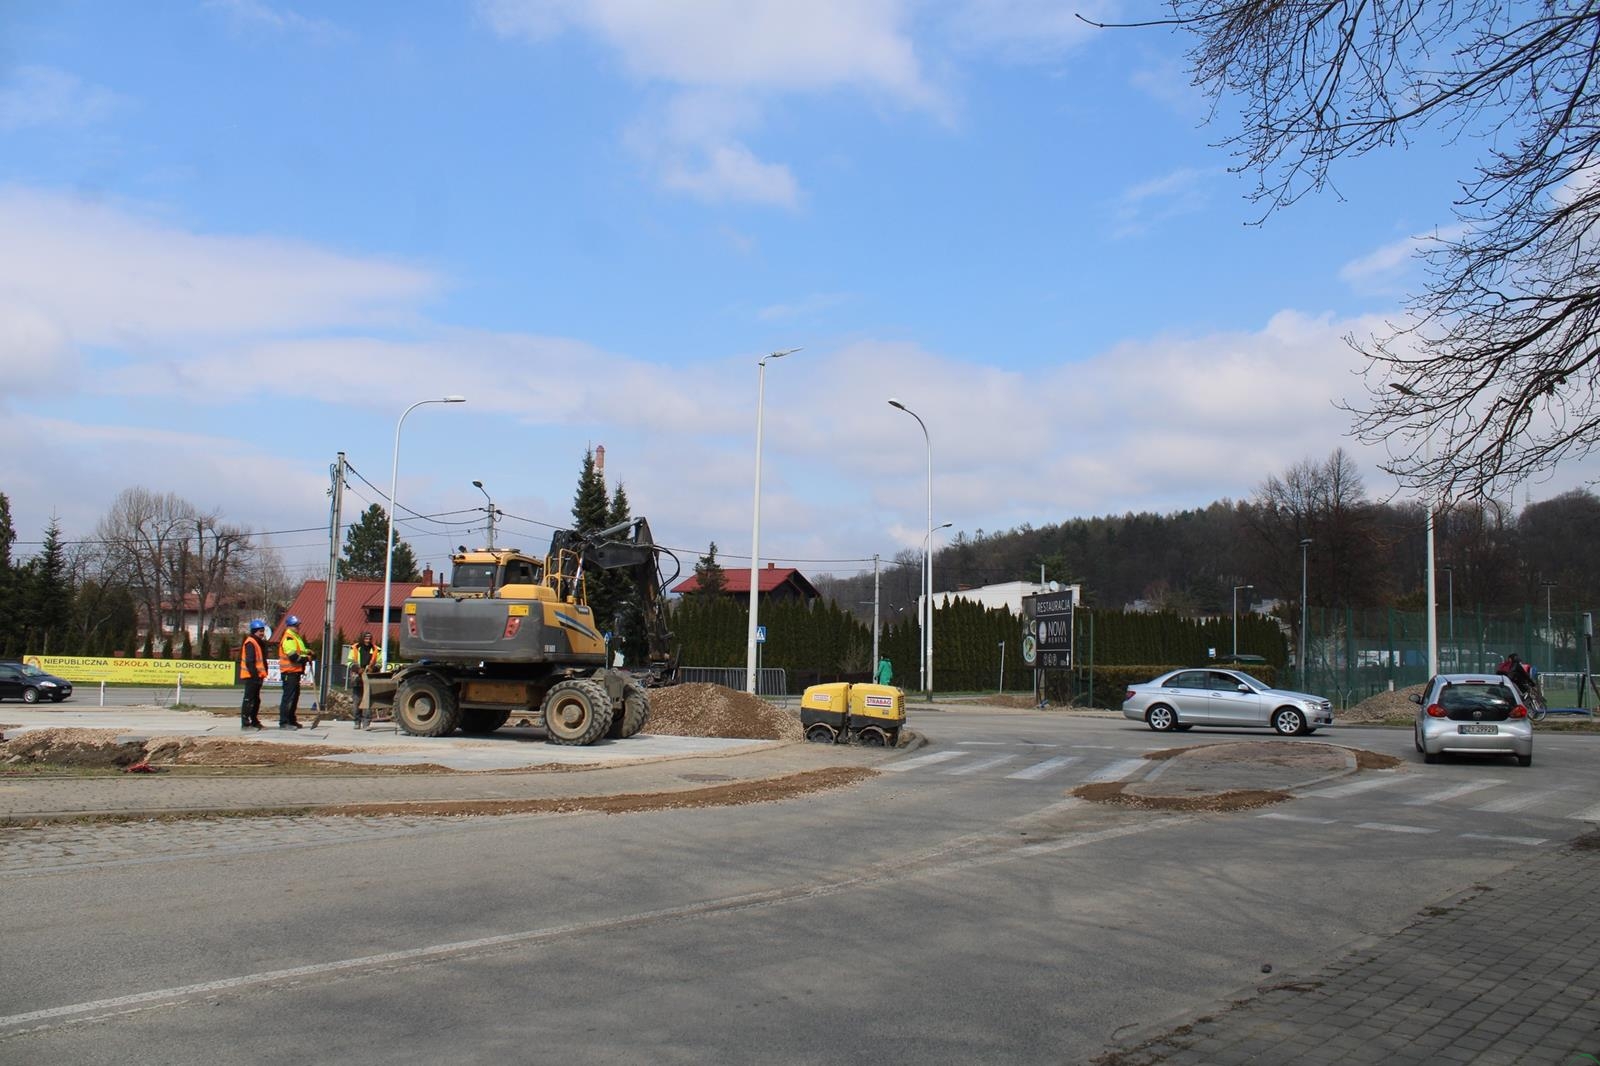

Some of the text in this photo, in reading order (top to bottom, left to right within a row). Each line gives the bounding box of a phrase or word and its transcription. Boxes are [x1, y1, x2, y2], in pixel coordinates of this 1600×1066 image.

[1037, 599, 1070, 613] RESTAURACJA
[1048, 620, 1067, 636] NOVA
[43, 658, 109, 666] NIEPUBLICZNA
[175, 661, 231, 670] DOROSŁYCH
[866, 697, 892, 706] STRABAG
